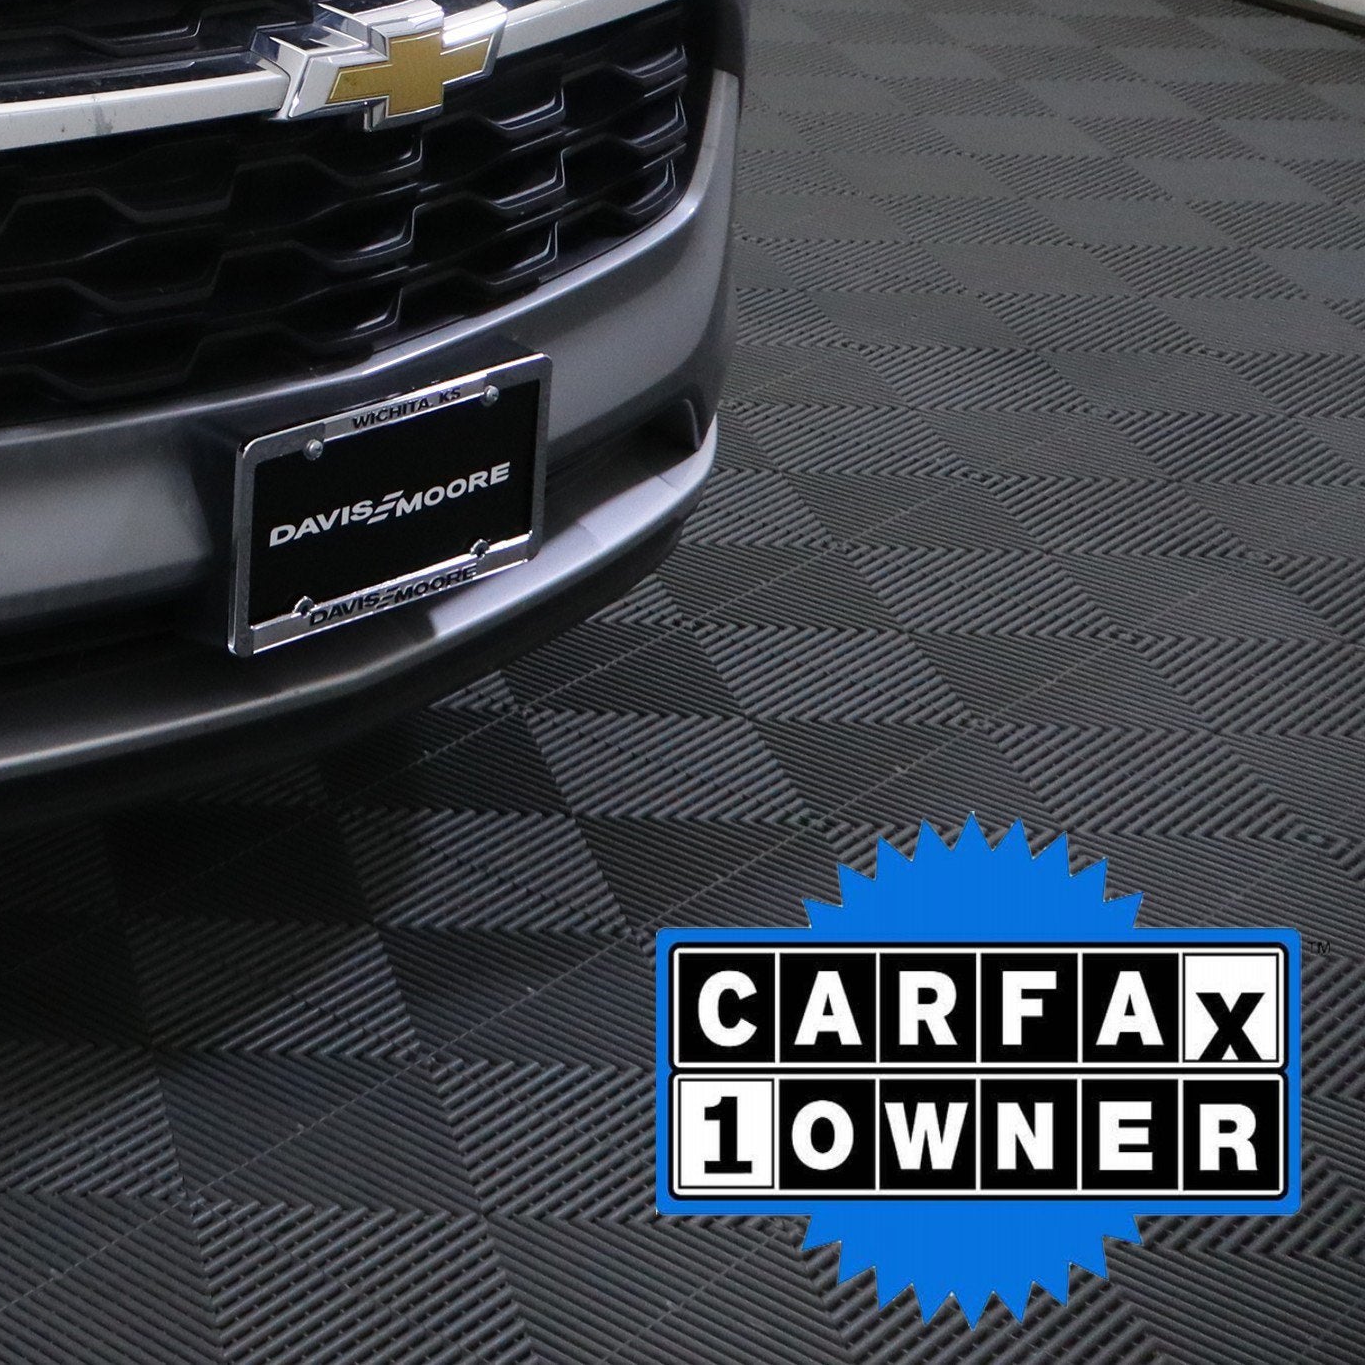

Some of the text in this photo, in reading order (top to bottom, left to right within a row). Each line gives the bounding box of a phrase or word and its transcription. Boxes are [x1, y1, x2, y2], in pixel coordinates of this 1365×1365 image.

[438, 387, 461, 404] KS
[269, 461, 511, 547] DAVIS MOORE
[309, 563, 477, 626] DAVIS MOORE
